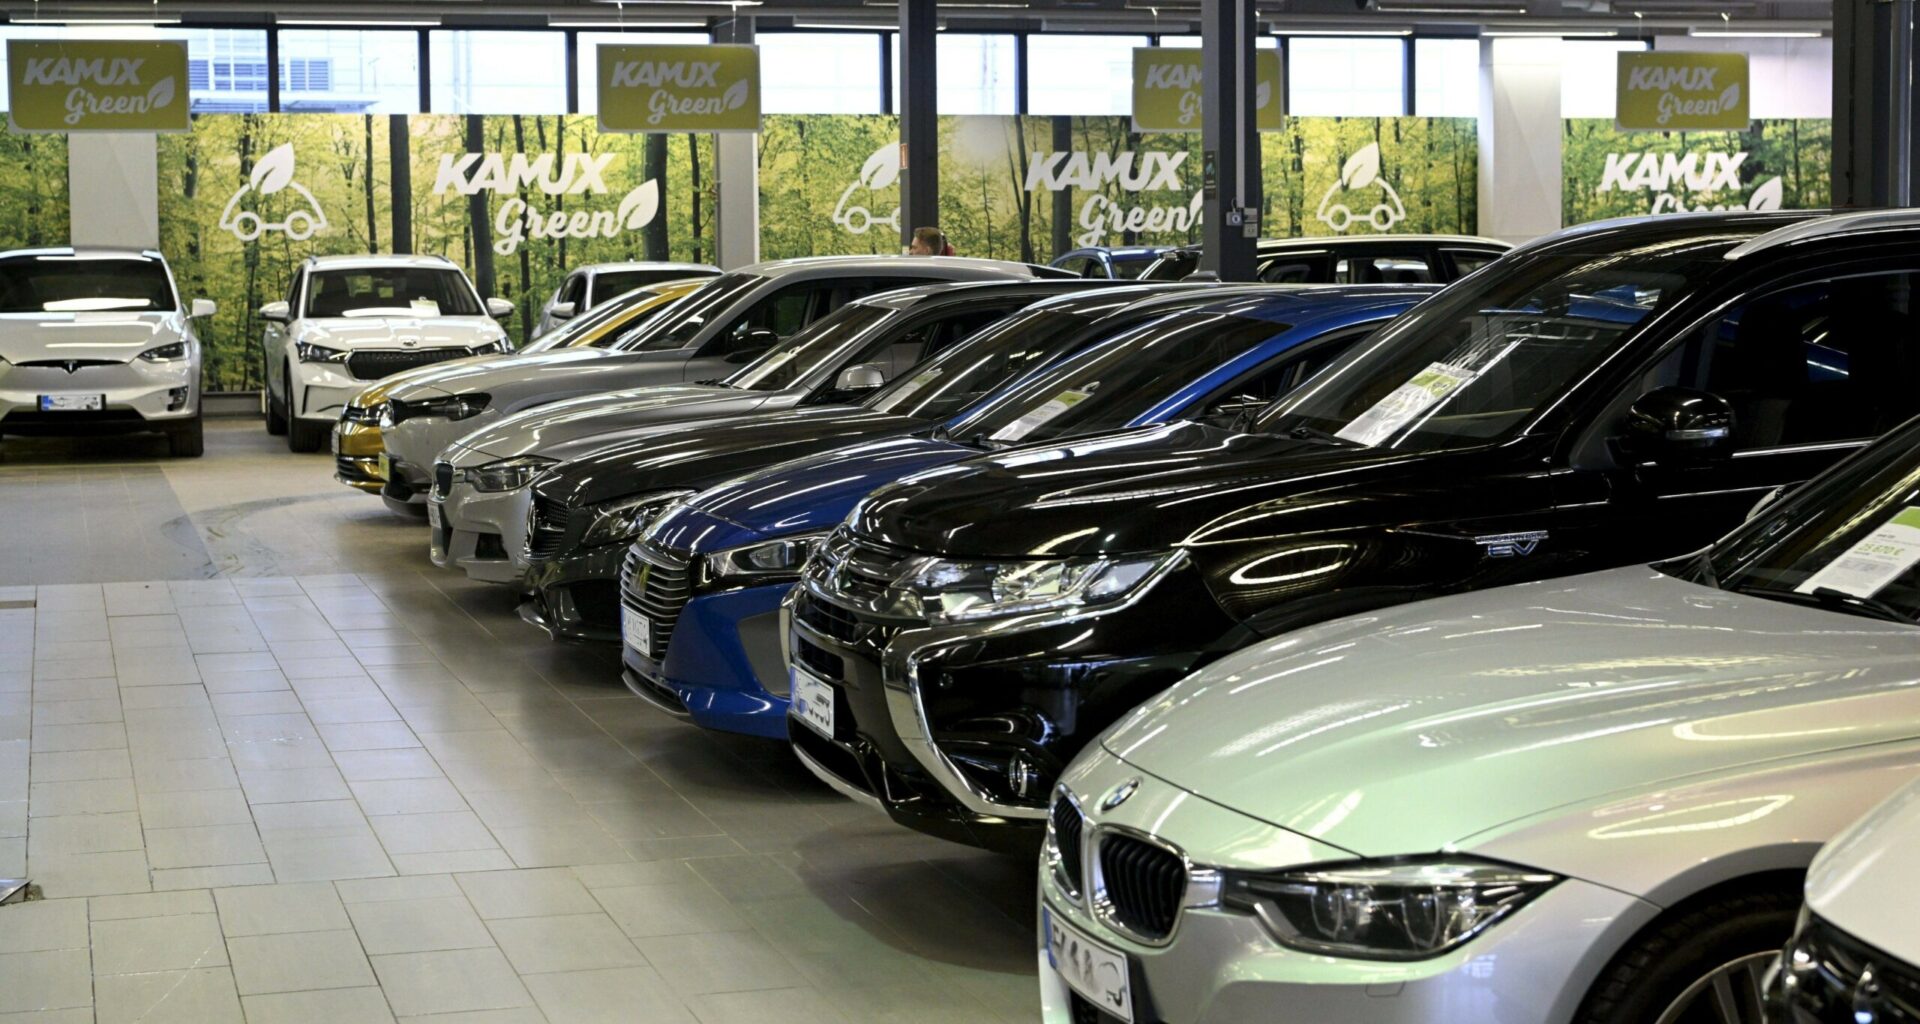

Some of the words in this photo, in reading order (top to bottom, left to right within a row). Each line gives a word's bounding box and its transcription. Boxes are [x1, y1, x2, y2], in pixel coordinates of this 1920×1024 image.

[23, 57, 146, 86] KAMUX
[610, 61, 721, 88] KAMUX
[1144, 64, 1203, 89] KAM
[1627, 66, 1718, 91] KAMUX
[64, 87, 149, 125] Green
[647, 89, 724, 125] Green
[1656, 92, 1721, 124] Green
[432, 152, 616, 195] KAMUX
[1024, 151, 1190, 191] KAMUX
[1600, 152, 1749, 191] KAMUX
[493, 198, 621, 256] Green
[1078, 194, 1194, 248] Green
[1488, 540, 1539, 558] EV
